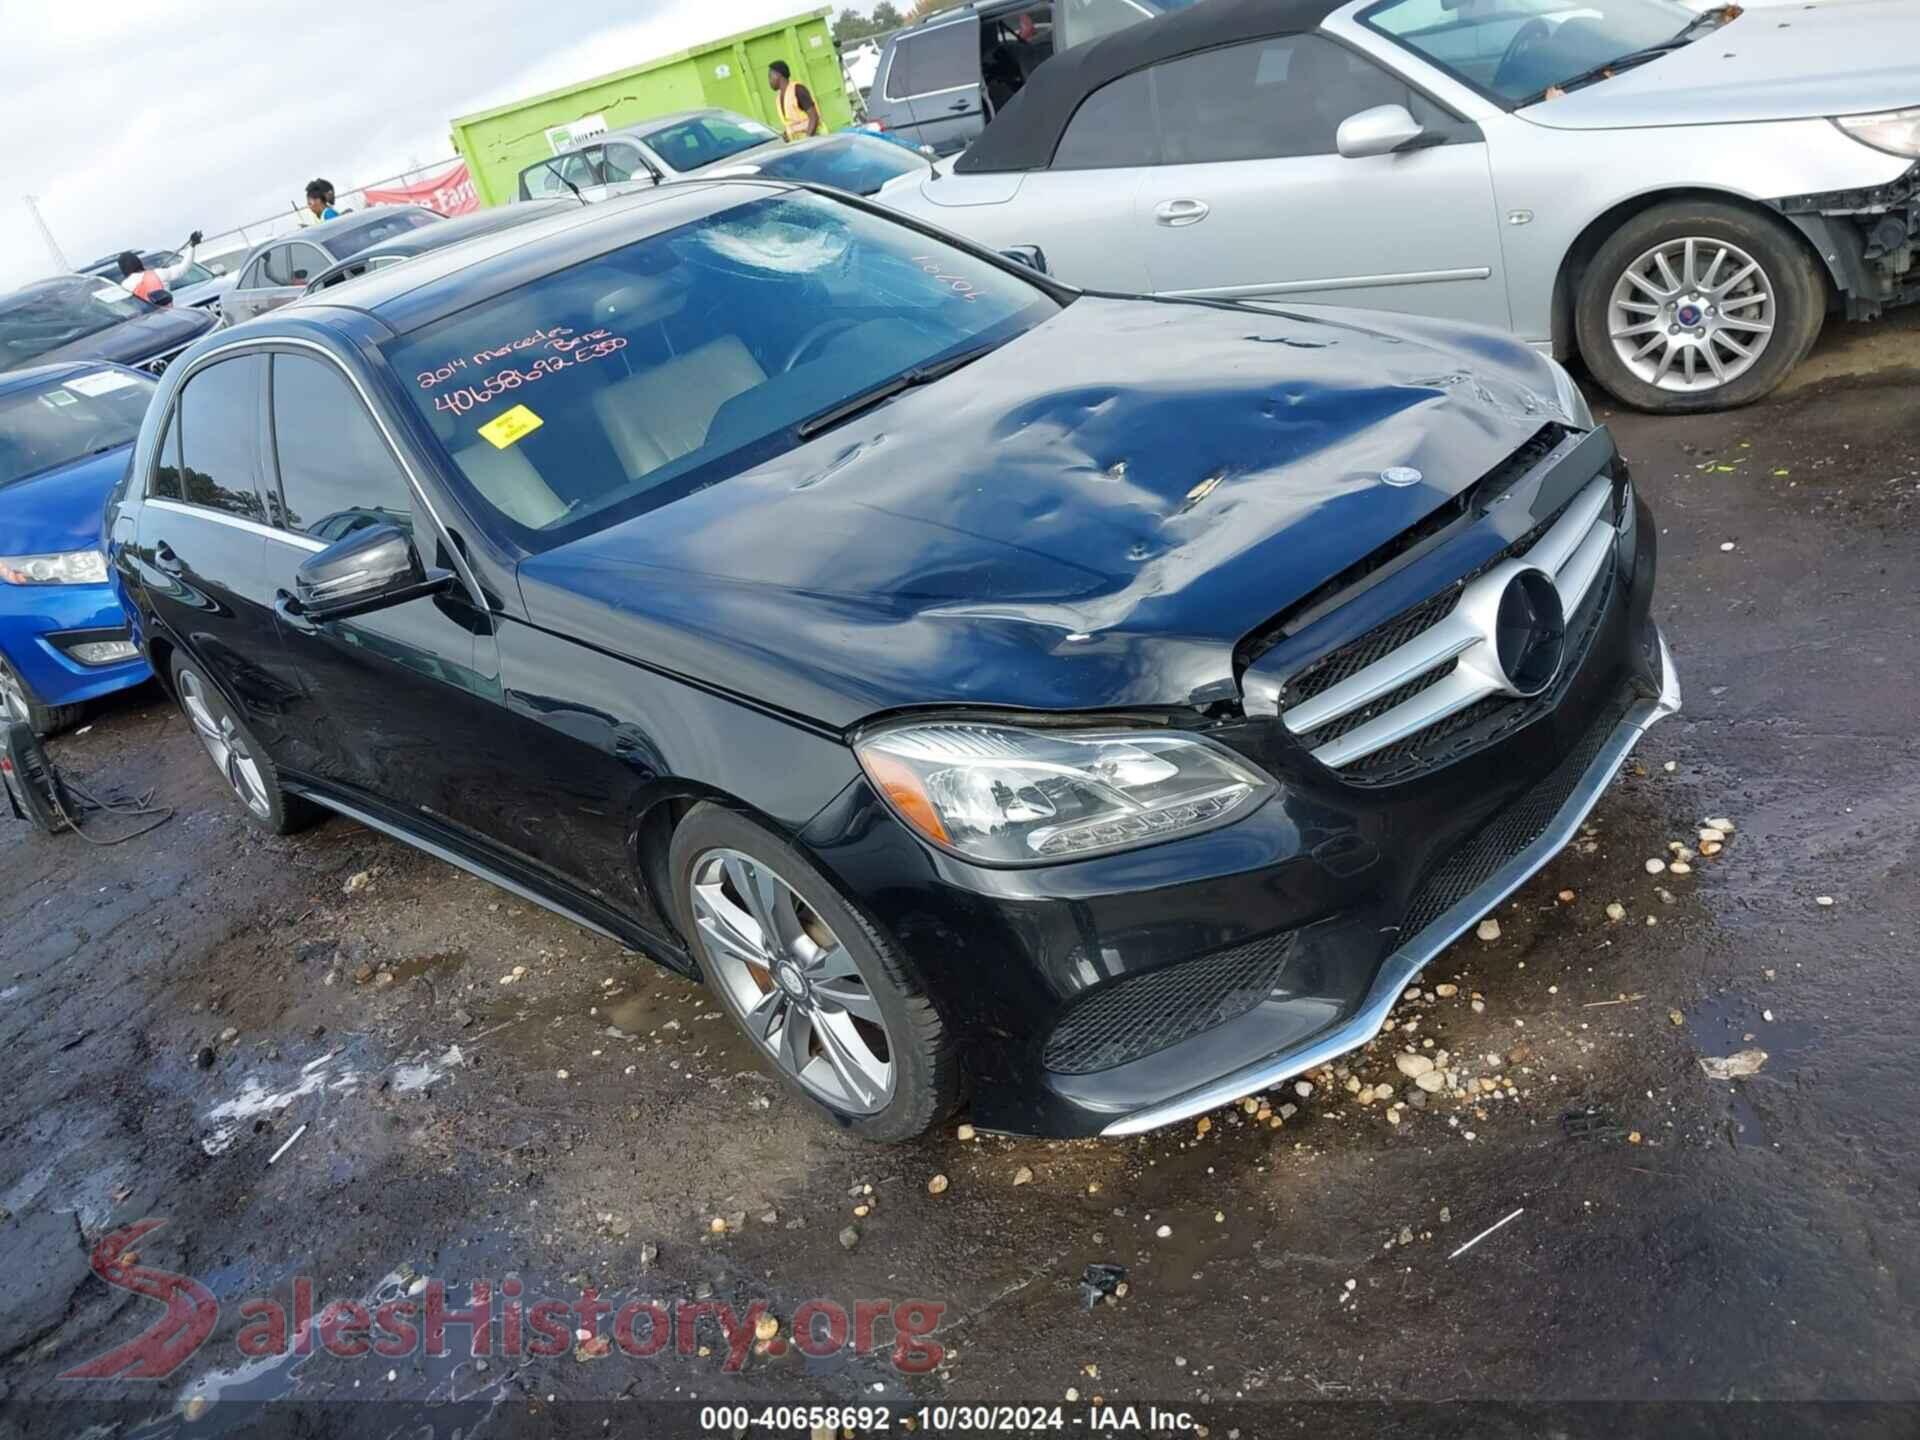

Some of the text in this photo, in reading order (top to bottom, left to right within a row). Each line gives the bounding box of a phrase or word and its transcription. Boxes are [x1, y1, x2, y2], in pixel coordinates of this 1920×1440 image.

[416, 357, 468, 389] 2014
[434, 337, 628, 416] 40658692 E350
